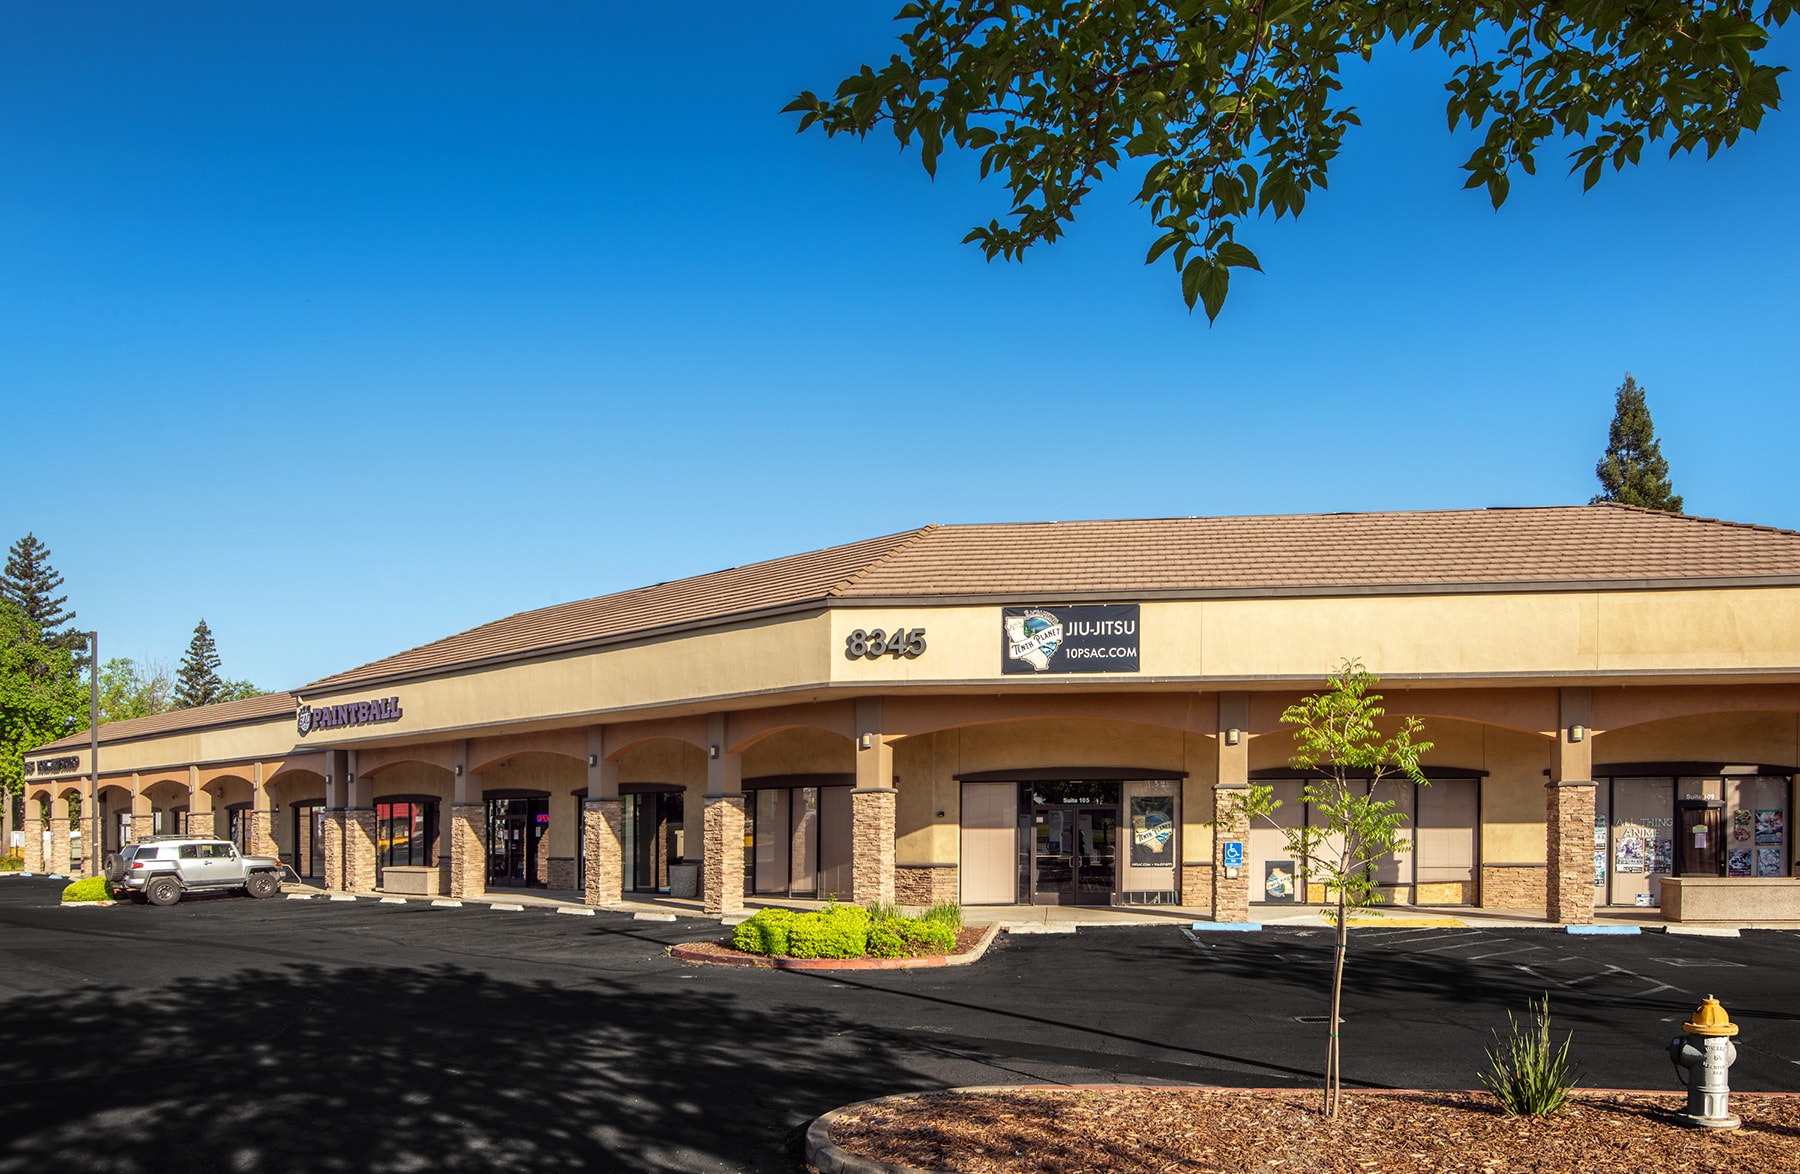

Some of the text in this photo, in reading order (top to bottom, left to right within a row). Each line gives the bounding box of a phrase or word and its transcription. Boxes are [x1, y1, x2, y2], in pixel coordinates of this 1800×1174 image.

[1065, 620, 1135, 636] JIU-JITSU
[846, 627, 926, 660] 8345
[1011, 628, 1060, 655] TENTH PLANET
[1065, 646, 1137, 659] 10PSAC.COM
[311, 697, 402, 731] PAINTBALL
[1615, 818, 1673, 827] ALL THING
[1623, 829, 1660, 838] ANIME
